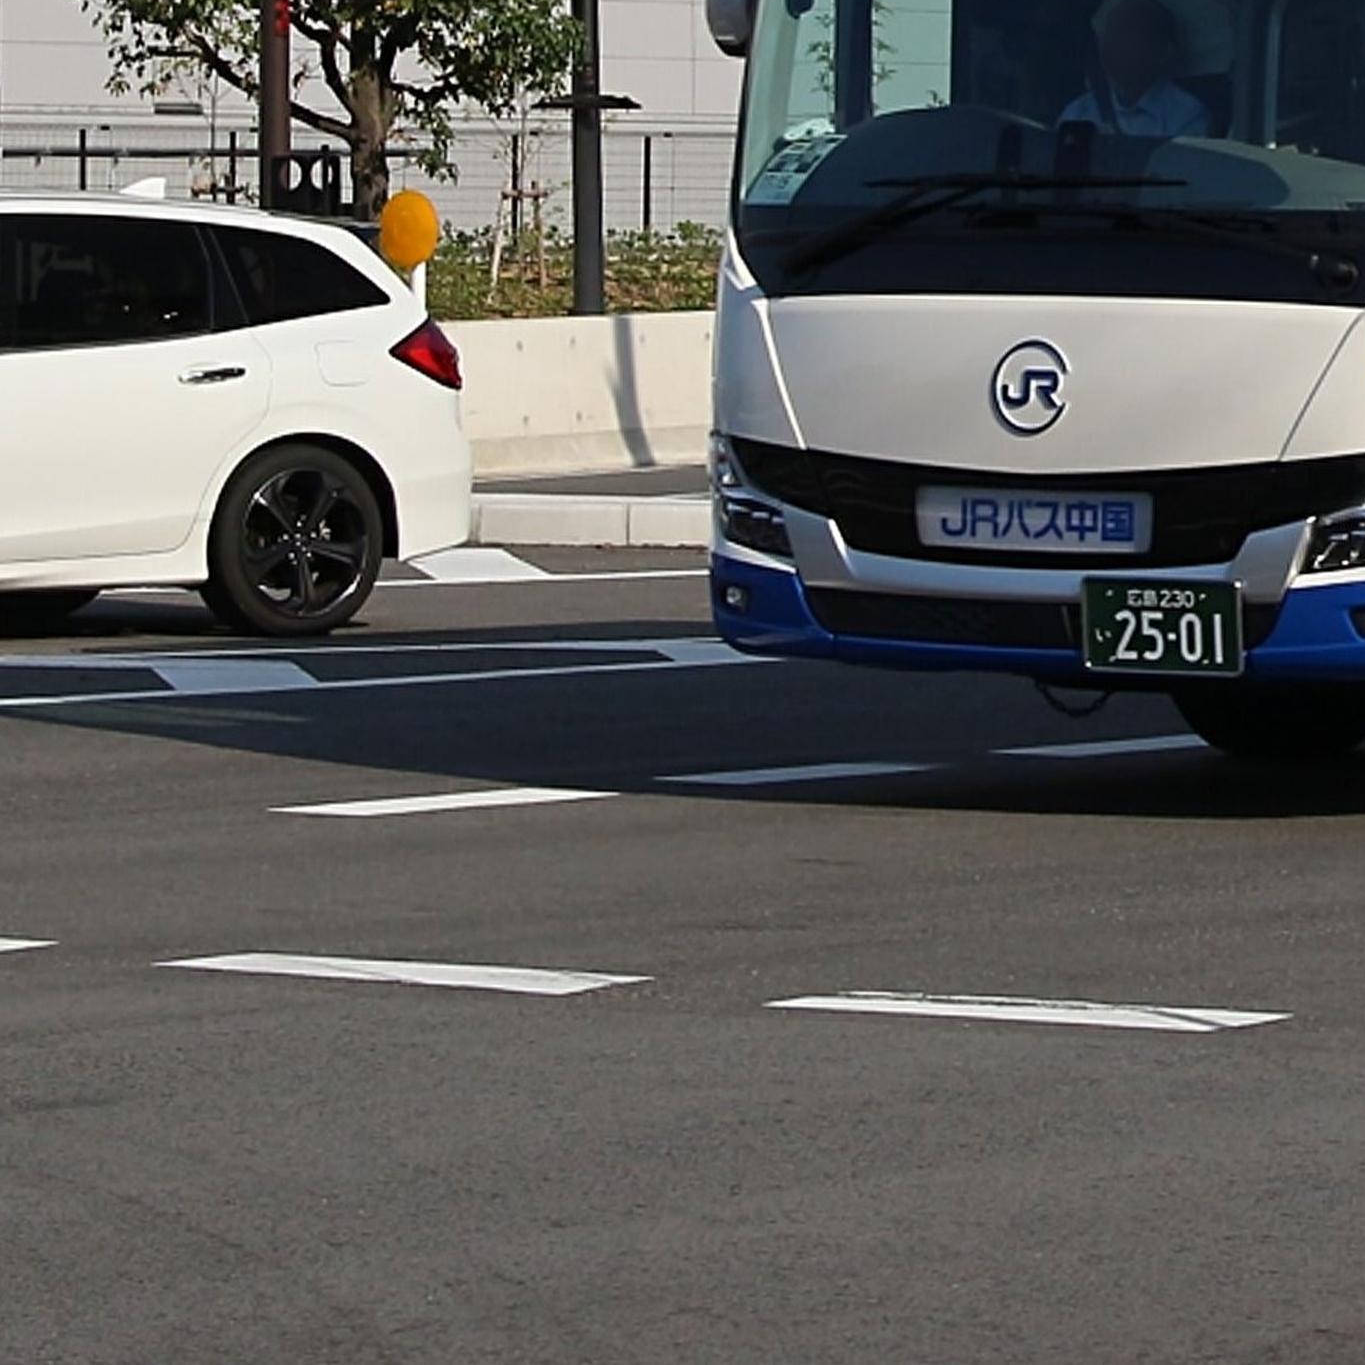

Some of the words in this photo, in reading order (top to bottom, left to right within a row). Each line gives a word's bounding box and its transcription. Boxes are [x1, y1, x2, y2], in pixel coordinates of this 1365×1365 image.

[940, 496, 1136, 543] JRバス中国
[1114, 608, 1225, 665] 25-01
